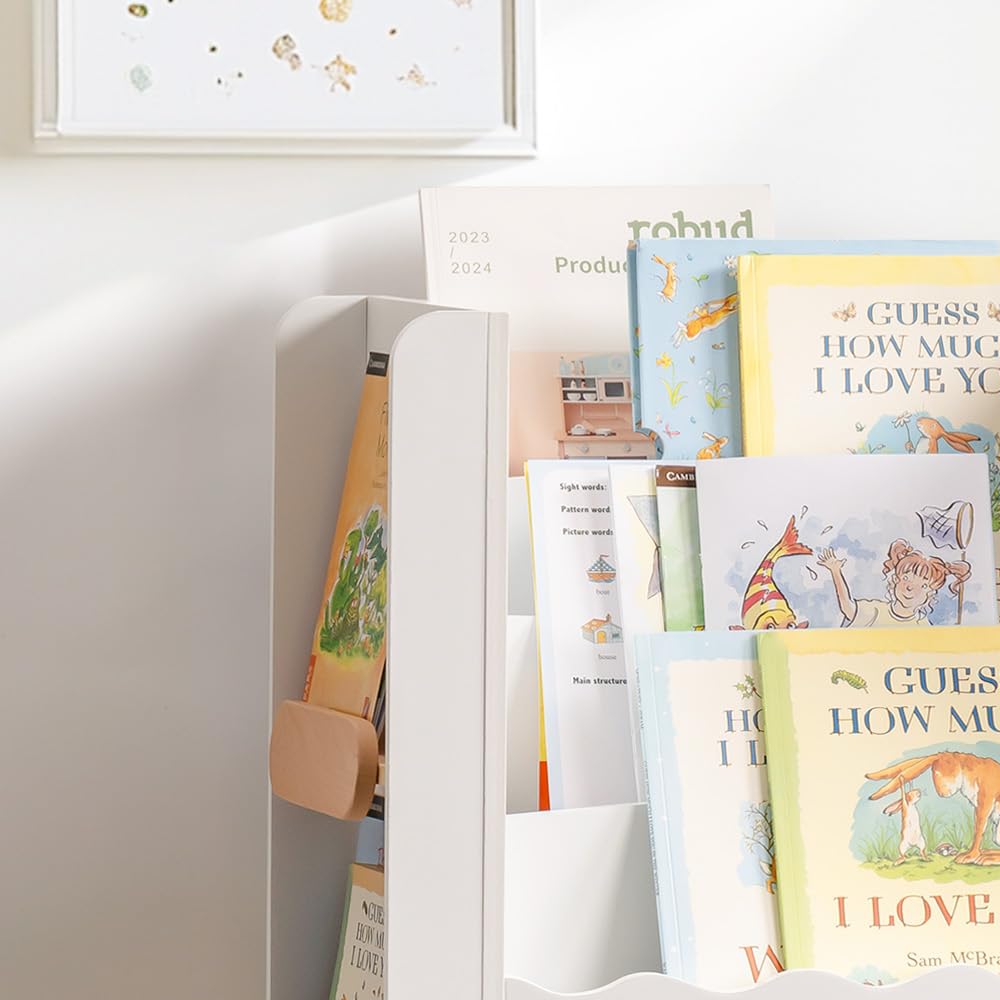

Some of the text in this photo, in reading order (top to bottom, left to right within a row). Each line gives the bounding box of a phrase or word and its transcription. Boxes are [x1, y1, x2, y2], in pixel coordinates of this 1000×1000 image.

[627, 209, 754, 239] robud
[449, 231, 489, 243] 2023
[451, 261, 491, 274] 2024
[867, 301, 980, 326] GUESS
[820, 334, 908, 359] HOW
[813, 367, 826, 393] I
[841, 366, 945, 395] LOVE
[560, 483, 607, 492] Sight words:
[561, 505, 589, 513] Pattern
[563, 528, 589, 536] Picture
[573, 676, 627, 685] Main structure
[829, 706, 935, 735] HOW
[717, 739, 732, 766] I
[834, 896, 851, 928] I
[867, 893, 995, 929] LOVE
[356, 922, 374, 943] HOW
[351, 945, 356, 966] I
[356, 948, 379, 976] LOVE
[907, 952, 942, 967] Sam
